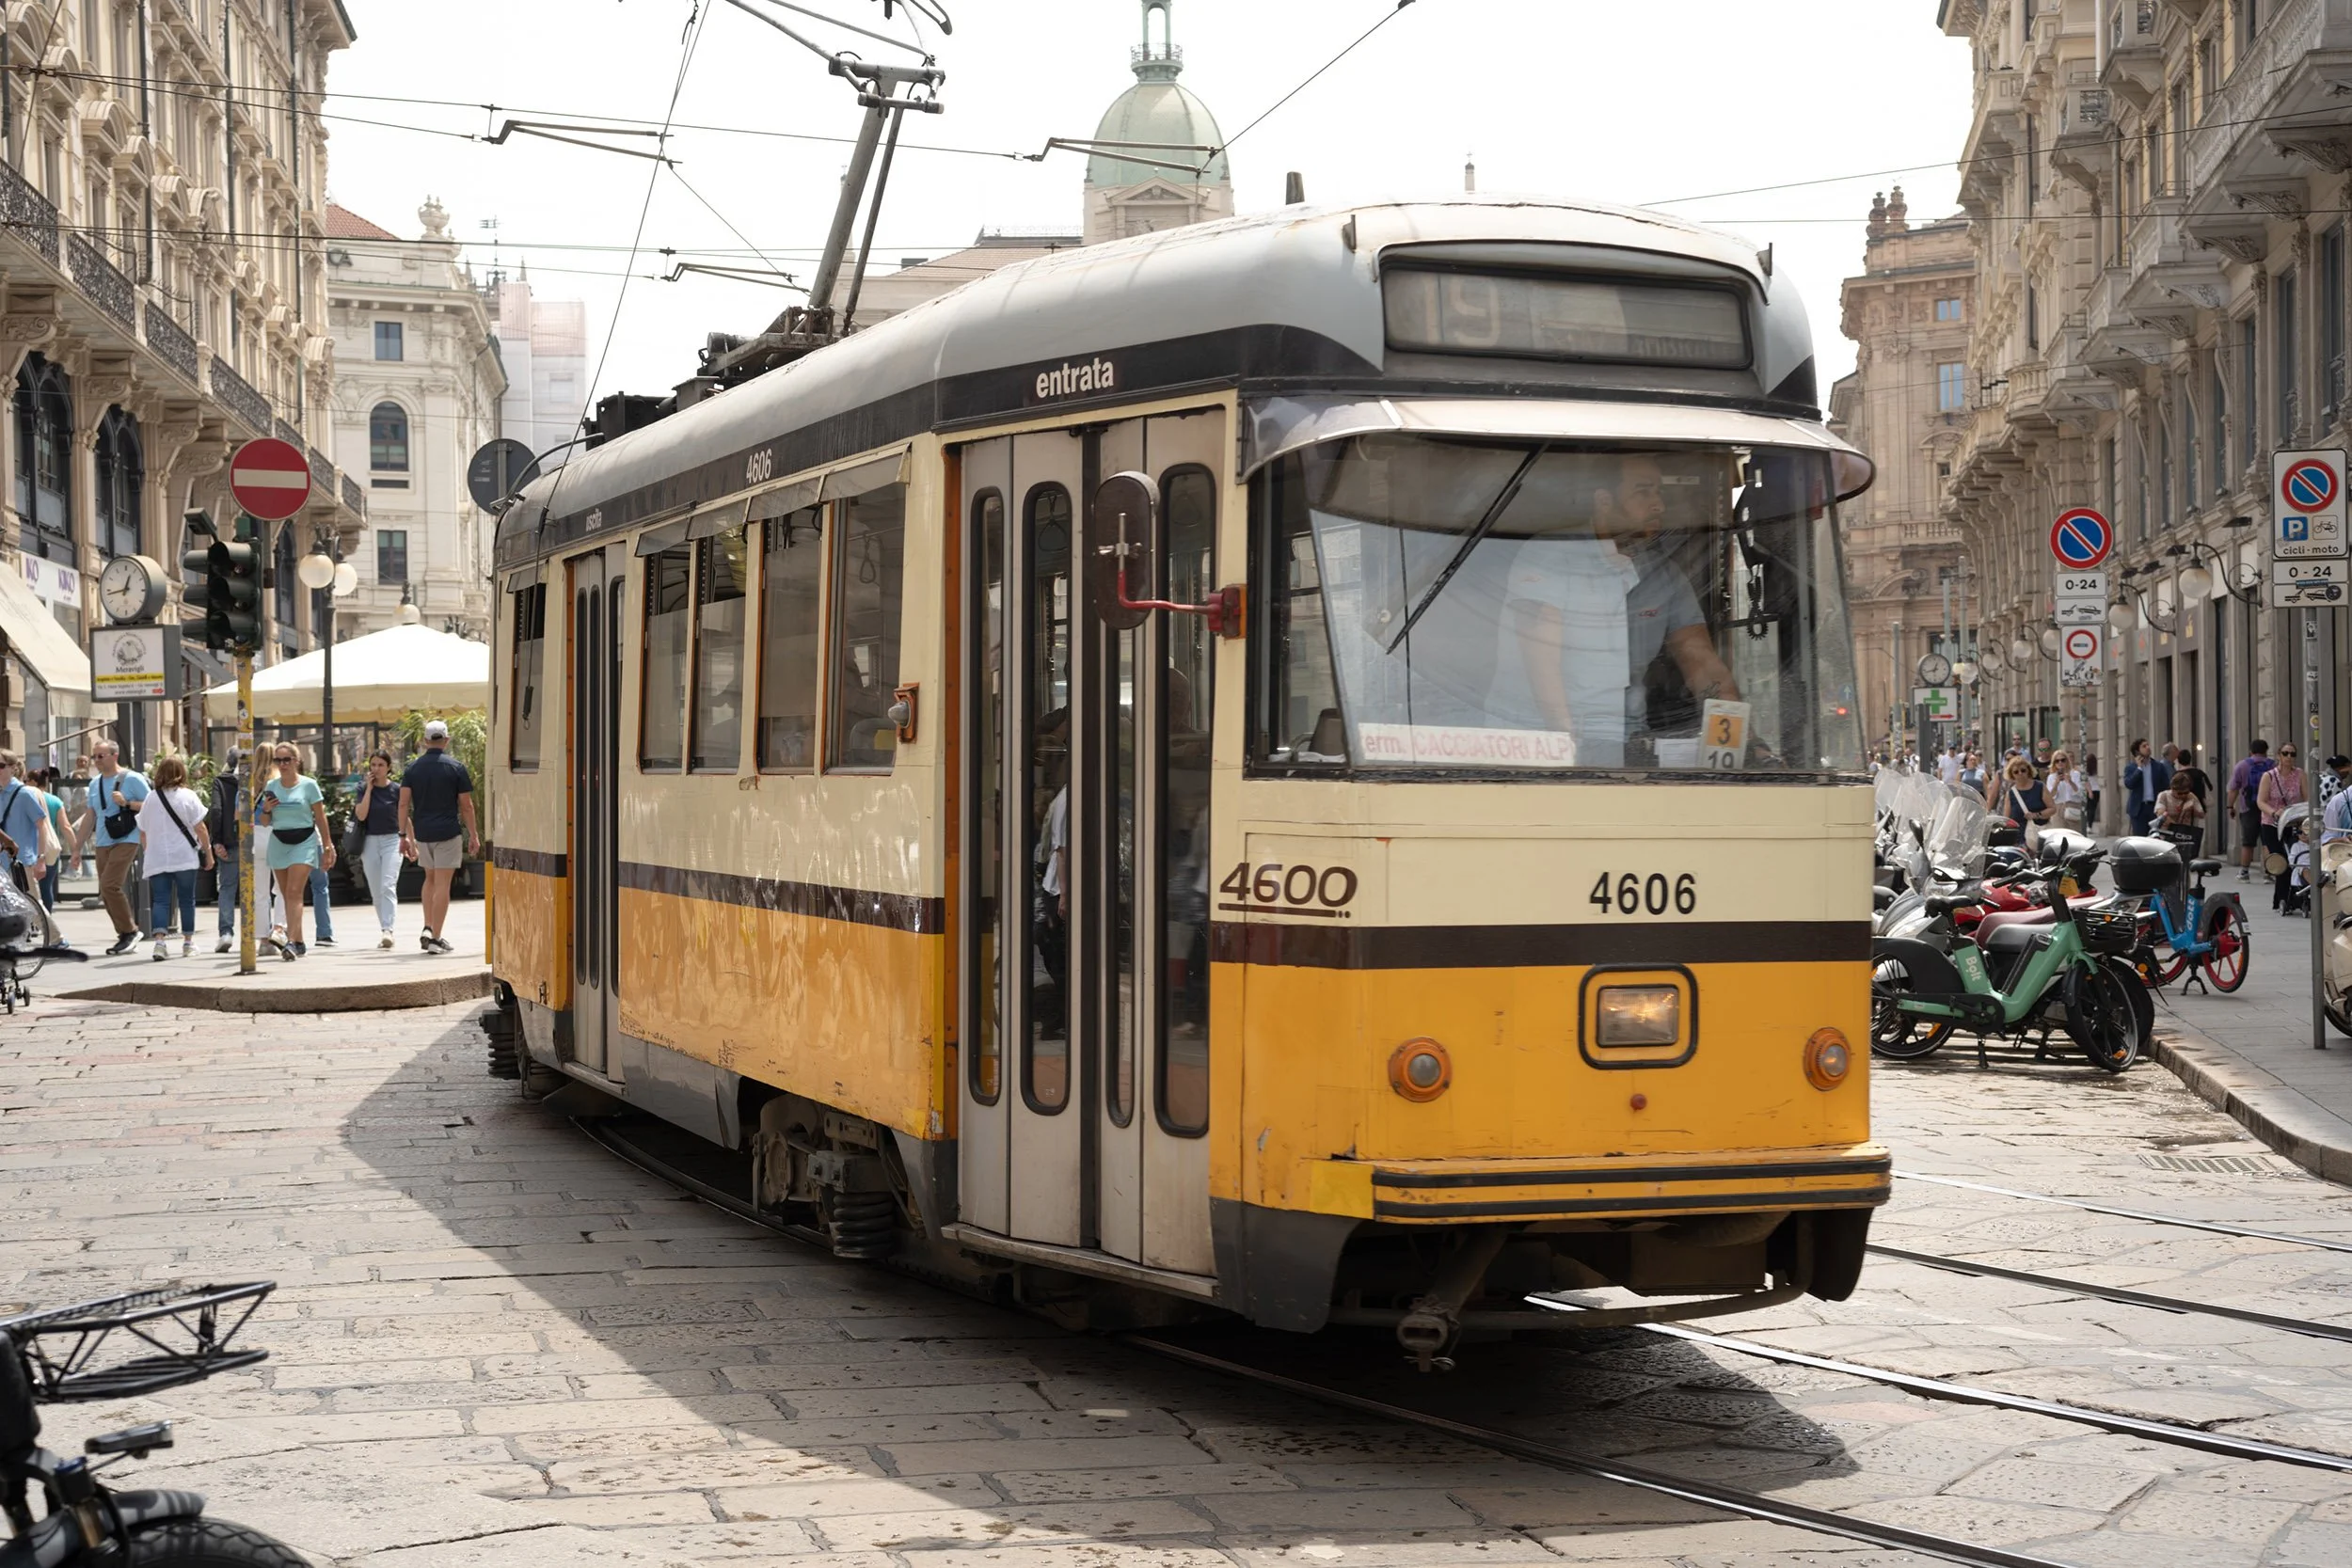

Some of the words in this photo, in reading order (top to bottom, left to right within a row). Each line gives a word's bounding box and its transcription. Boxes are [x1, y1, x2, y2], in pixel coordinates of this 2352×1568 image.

[1422, 275, 1503, 347] 19
[1036, 357, 1114, 398] entrata
[746, 448, 772, 483] 4606
[1365, 735, 1407, 754] erm.
[1413, 730, 1531, 760] CACCIATORI
[1717, 718, 1731, 745] 3
[1219, 862, 1359, 908] 4600
[1590, 871, 1696, 915] 4606
[2186, 898, 2196, 931] dott
[1966, 955, 1981, 982] Bolt
